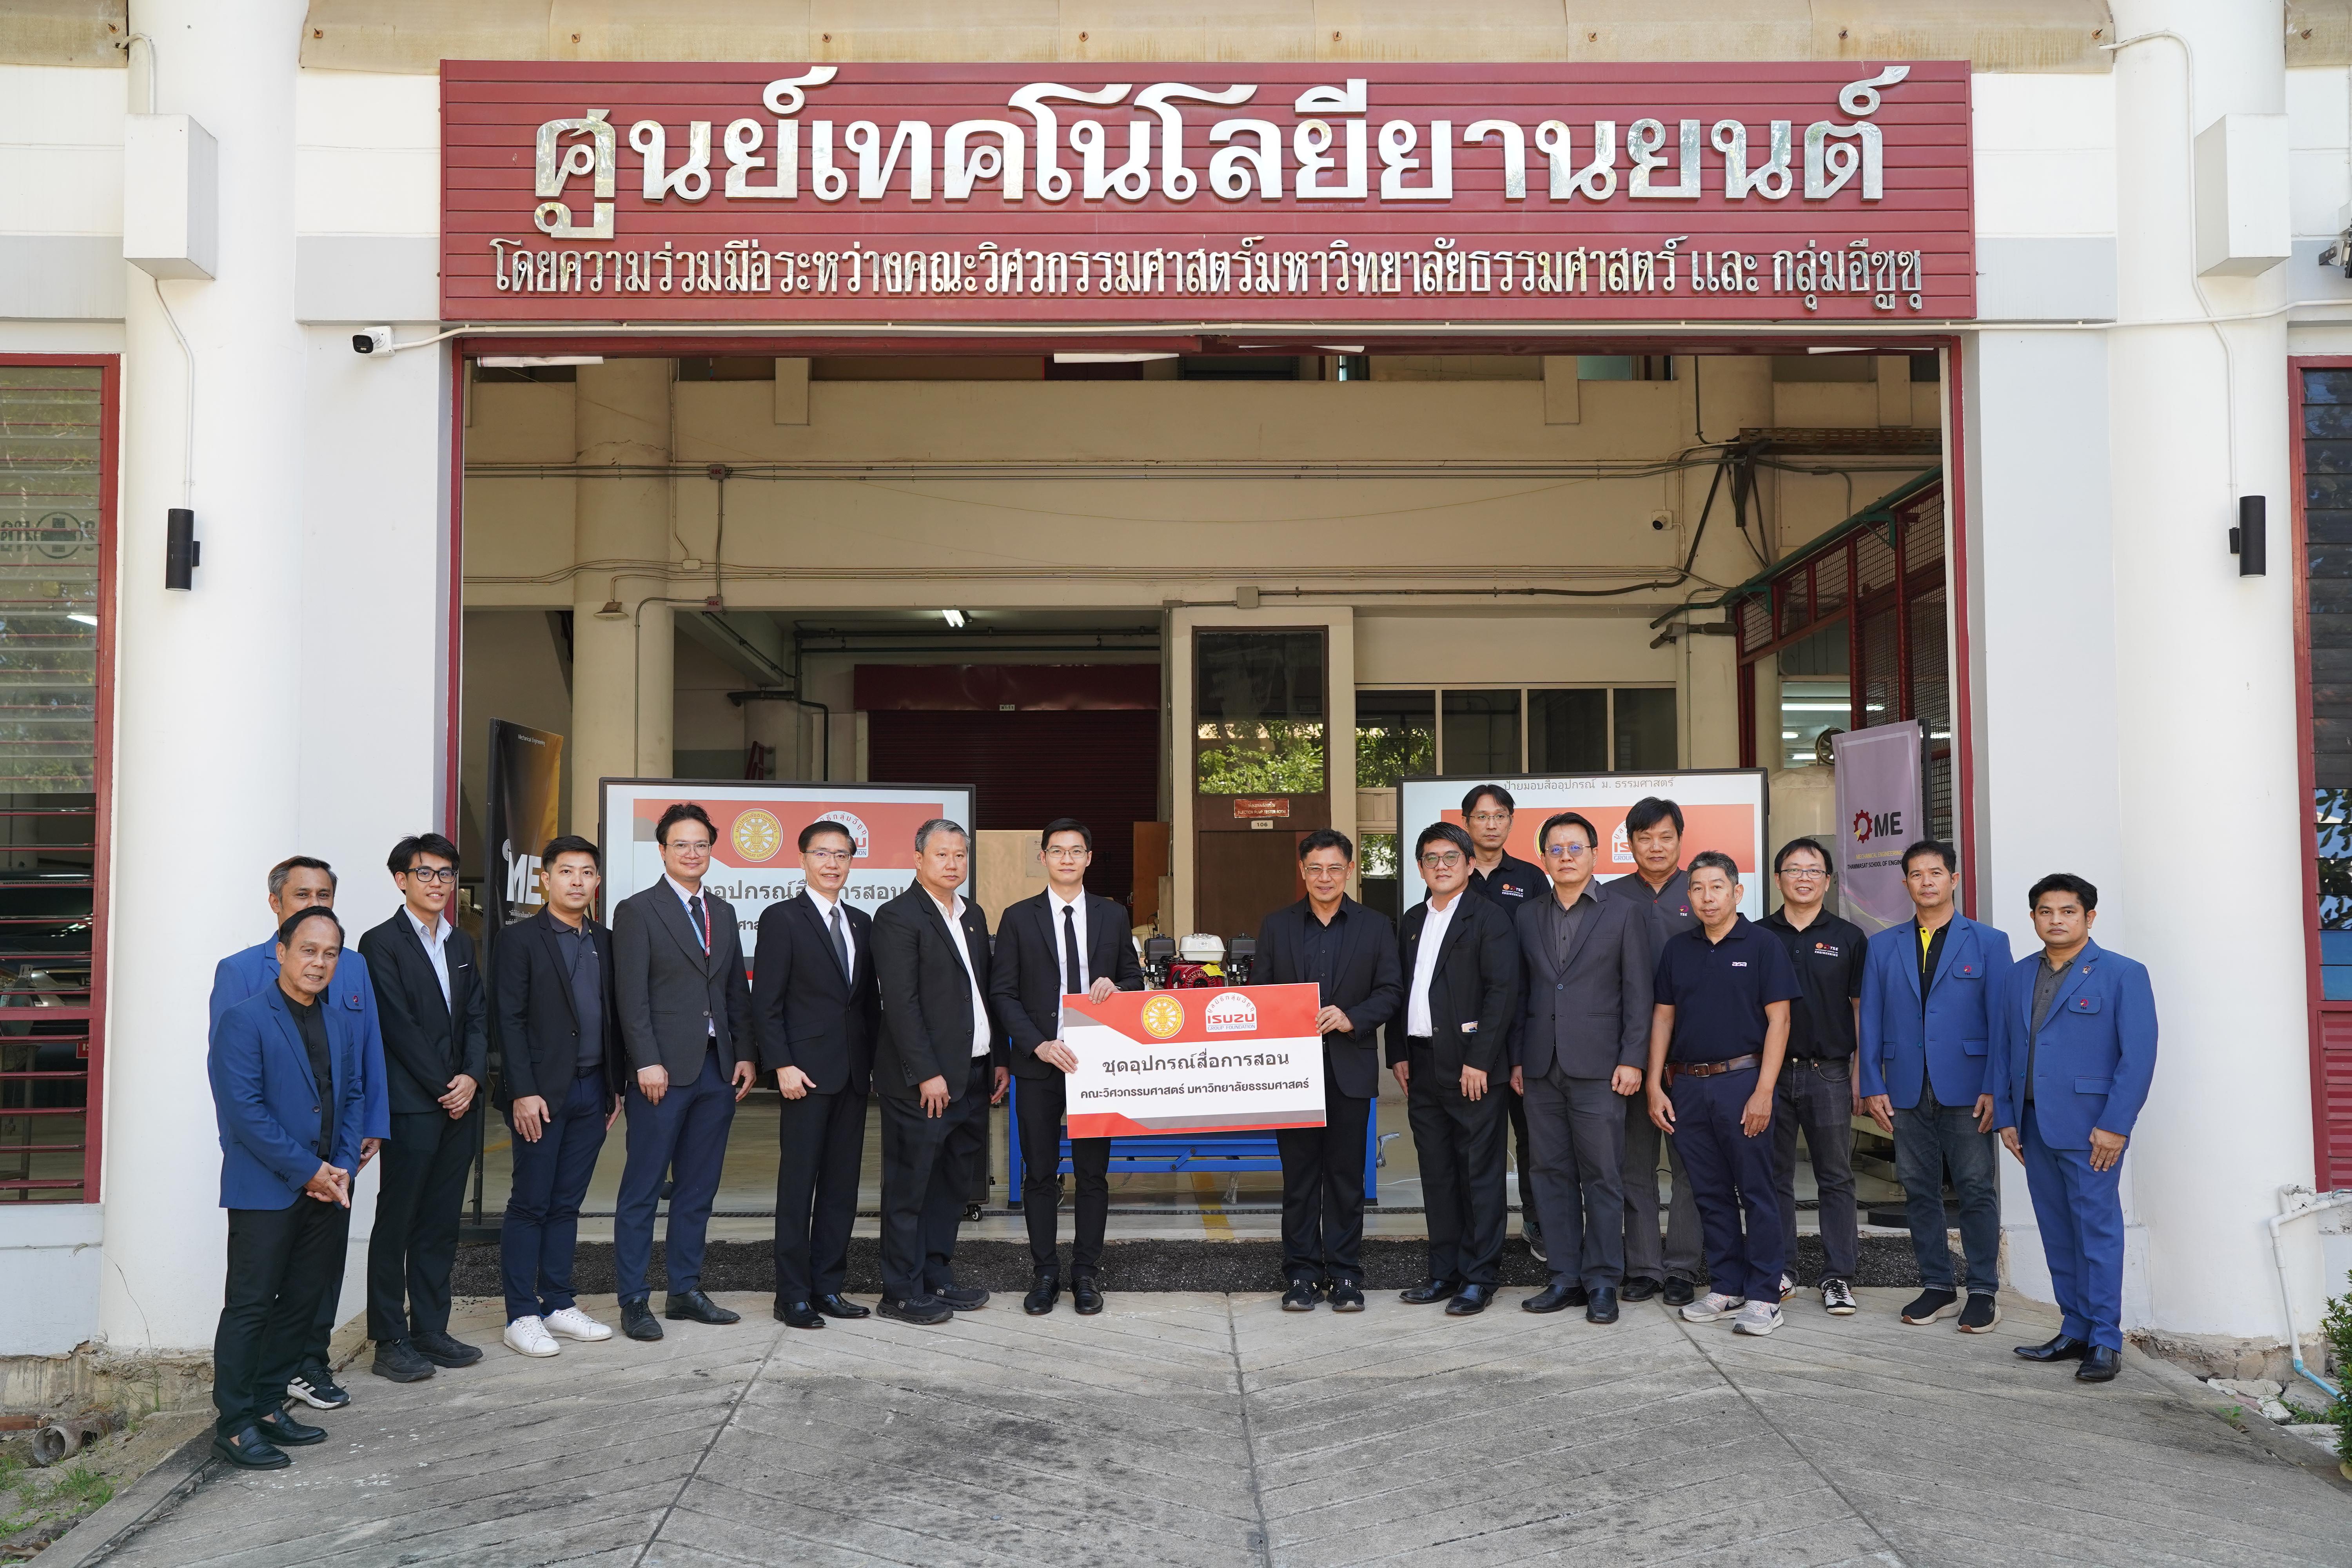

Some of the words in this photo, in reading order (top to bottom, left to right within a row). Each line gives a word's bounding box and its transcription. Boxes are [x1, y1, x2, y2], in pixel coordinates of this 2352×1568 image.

[533, 65, 1910, 240] ศูนย์เทคโนโลยียานยนต์
[1691, 250, 1759, 292] และ
[1772, 238, 1922, 311] กลุ่มอีซูซุ
[518, 734, 532, 742] Mechanical
[532, 737, 545, 747] Engineering
[1615, 777, 1676, 788] ธรรมศาสตร์
[1874, 811, 1903, 837] ME
[737, 841, 757, 858] THAMMASAT
[757, 842, 777, 858] UNIVERSITY
[506, 849, 542, 905] ME
[1146, 1022, 1163, 1035] THAMMASAT
[1163, 1022, 1180, 1035] UNIVERSITY
[1208, 1013, 1254, 1024] ISUZU
[1102, 1048, 1289, 1076] ชุดอุปกรณ์สื่อการสอน
[1081, 1083, 1185, 1099] คณะวิศวกรรมศาสตร์
[1187, 1077, 1310, 1094] มหาวิทยาลัยธรรมศาสตร์
